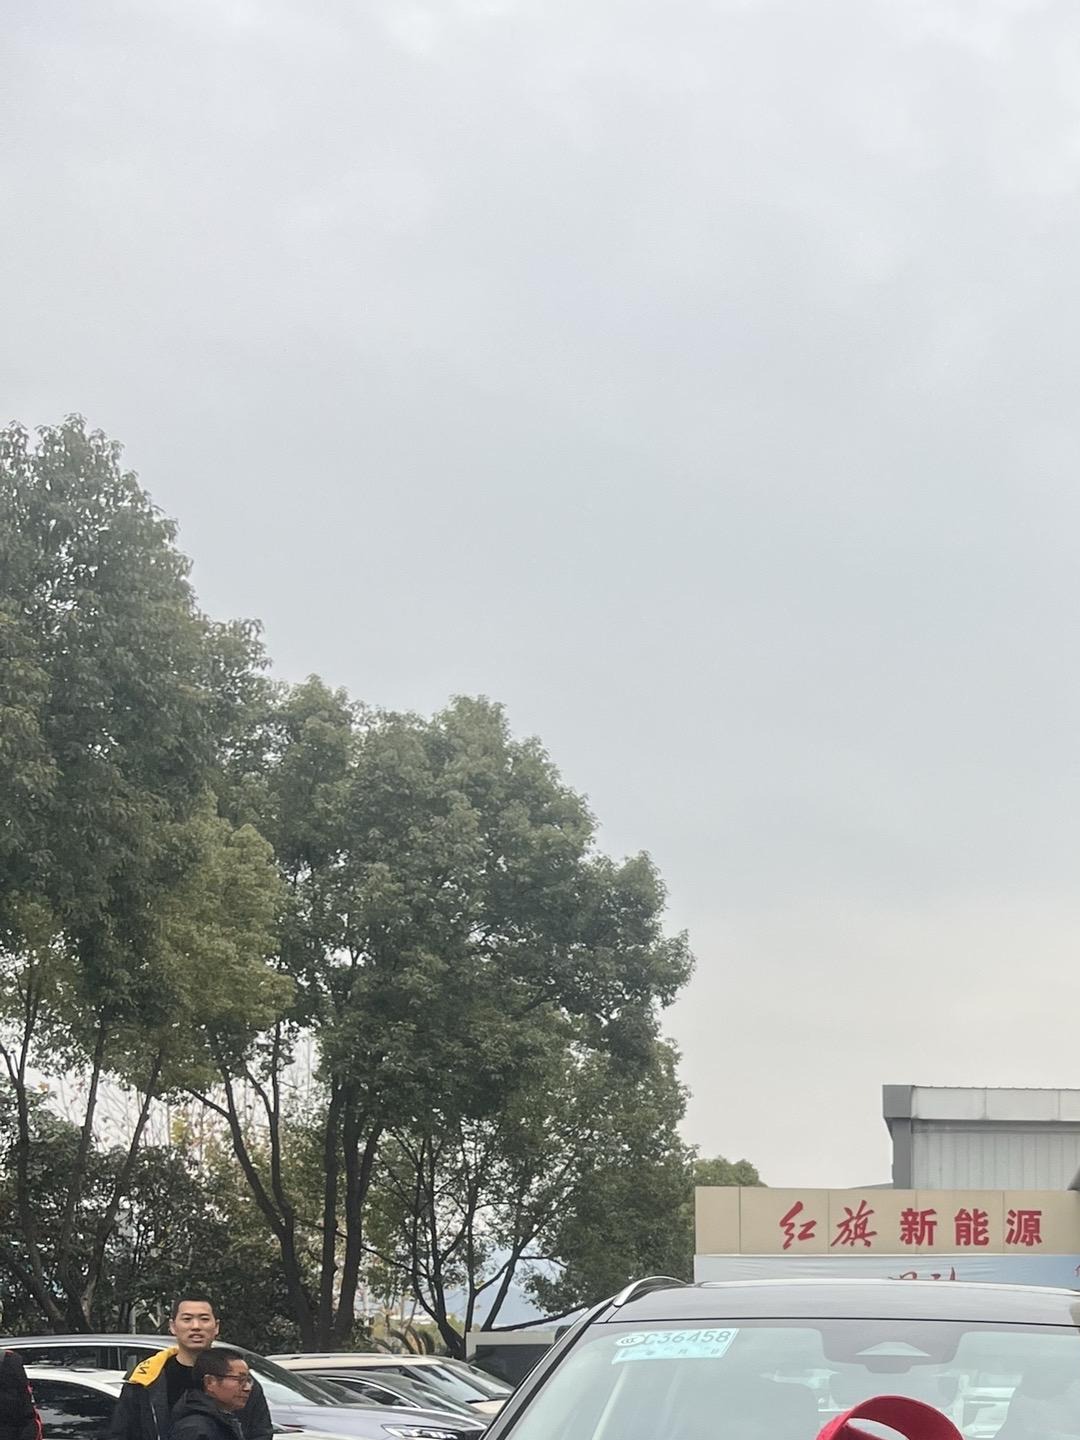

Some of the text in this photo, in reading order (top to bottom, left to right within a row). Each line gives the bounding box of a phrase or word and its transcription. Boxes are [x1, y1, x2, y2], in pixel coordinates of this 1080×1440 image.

[779, 1200, 1042, 1250] 红旗新能源
